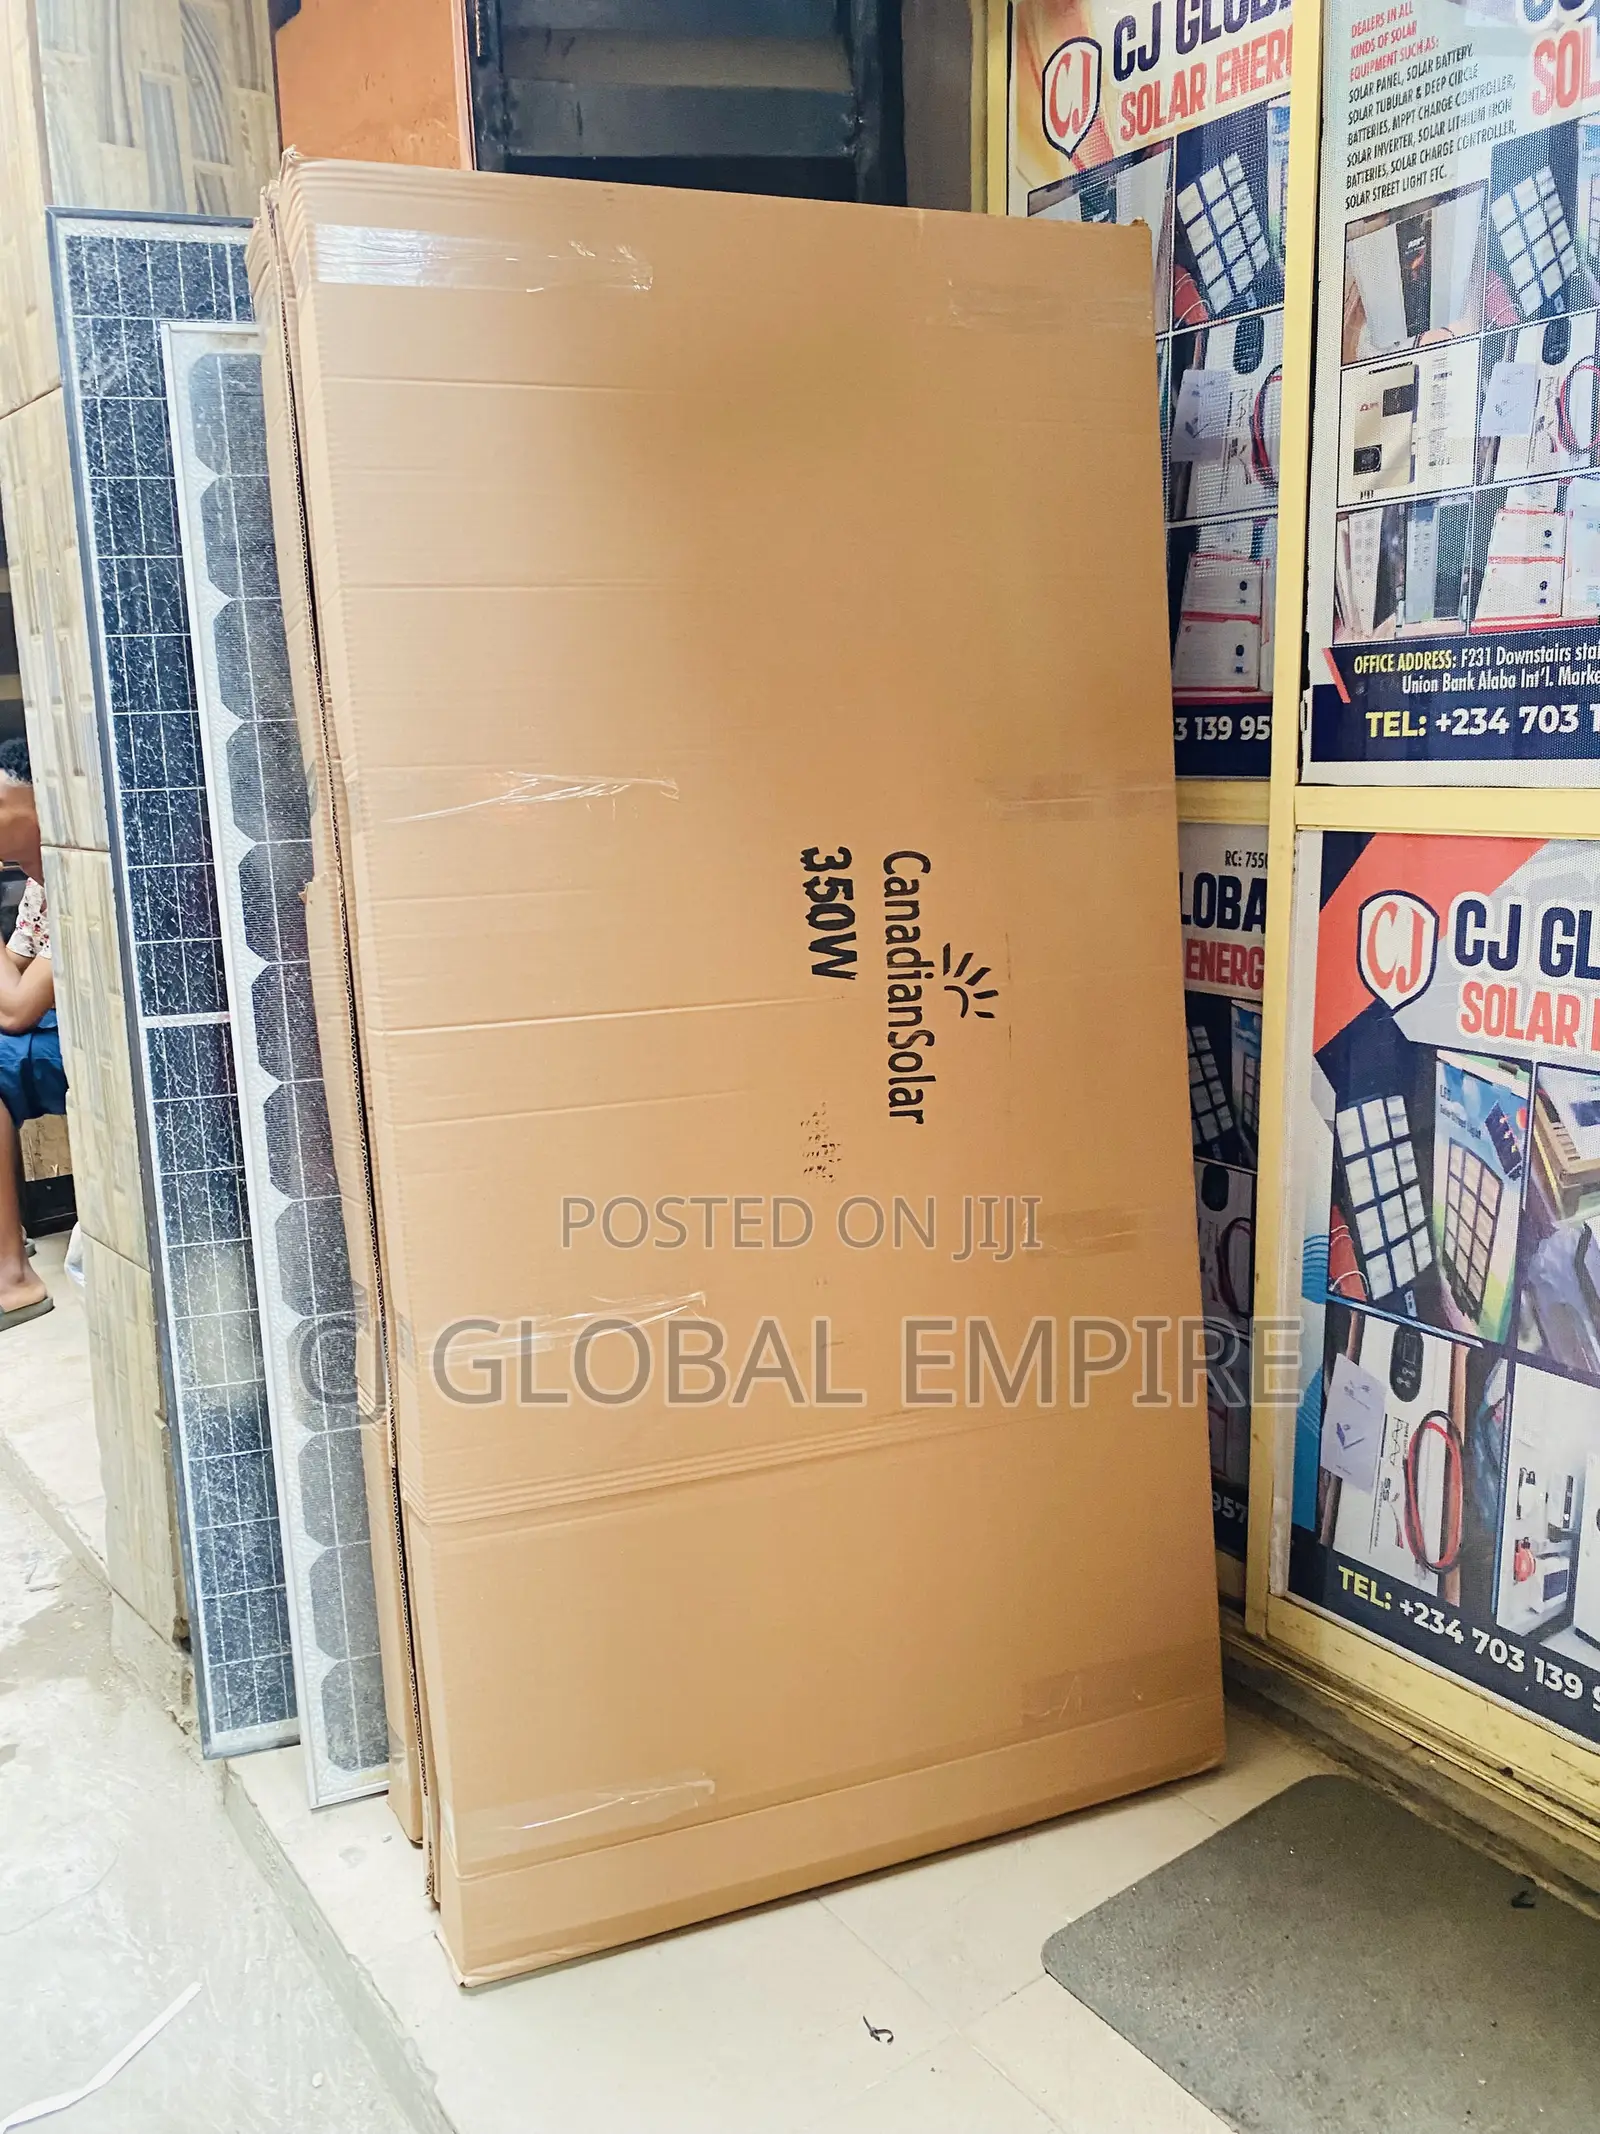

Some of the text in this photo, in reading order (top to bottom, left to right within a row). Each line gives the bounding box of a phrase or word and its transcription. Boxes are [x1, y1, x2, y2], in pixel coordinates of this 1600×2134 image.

[1113, 0, 1162, 82] CJ
[1350, 20, 1417, 60] KINDS OF SOLAR
[1351, 1, 1414, 39] DEALERS IN ALL
[1349, 82, 1374, 104] SOLAR
[1376, 71, 1404, 93] PANEL,
[1406, 58, 1434, 82] SOLAR
[1350, 36, 1439, 83] EQUIPMENT SUCH AS:
[1532, 27, 1600, 116] SOL
[1050, 50, 1092, 139] CJ
[1119, 62, 1207, 141] SOLAR
[1348, 63, 1479, 126] SOLAR TUBULAR & DEEP CIRCLE
[1348, 73, 1517, 146] BATTERIES, MPPT CHARGE CONTROLLER,
[1346, 119, 1517, 190] BATTERIES, SOLAR CHARGE CONTROLLER,
[1347, 98, 1513, 168] SOLAR INVERTER, SOLAR LITHIUM IRON
[1345, 164, 1448, 211] SOLAR STREET LIGHT ETC.
[1353, 653, 1394, 675] OFFICE
[1397, 649, 1457, 672] ADDRESS:
[1461, 648, 1491, 668] F231
[1496, 643, 1572, 666] Downstairs
[1402, 674, 1439, 695] Union
[1442, 672, 1475, 692] Bank
[1478, 670, 1516, 690] Alaba
[1194, 715, 1233, 741] 139
[1239, 714, 1272, 741] 95
[1364, 710, 1428, 738] TEL:
[1435, 706, 1510, 737] +234
[1519, 703, 1580, 735] 703
[1224, 850, 1243, 868] RC:
[799, 846, 859, 981] 350W
[1454, 899, 1600, 981] CJ GL
[1185, 938, 1265, 991] ENERG
[1366, 901, 1427, 994] CJ
[882, 850, 937, 1126] CanadianSolar
[1460, 981, 1581, 1048] SOLAR
[1212, 1490, 1248, 1524] 957
[1338, 1565, 1393, 1611] TEL:
[1399, 1599, 1465, 1645] +234
[1471, 1626, 1526, 1674] 703
[1533, 1656, 1583, 1700] 139
